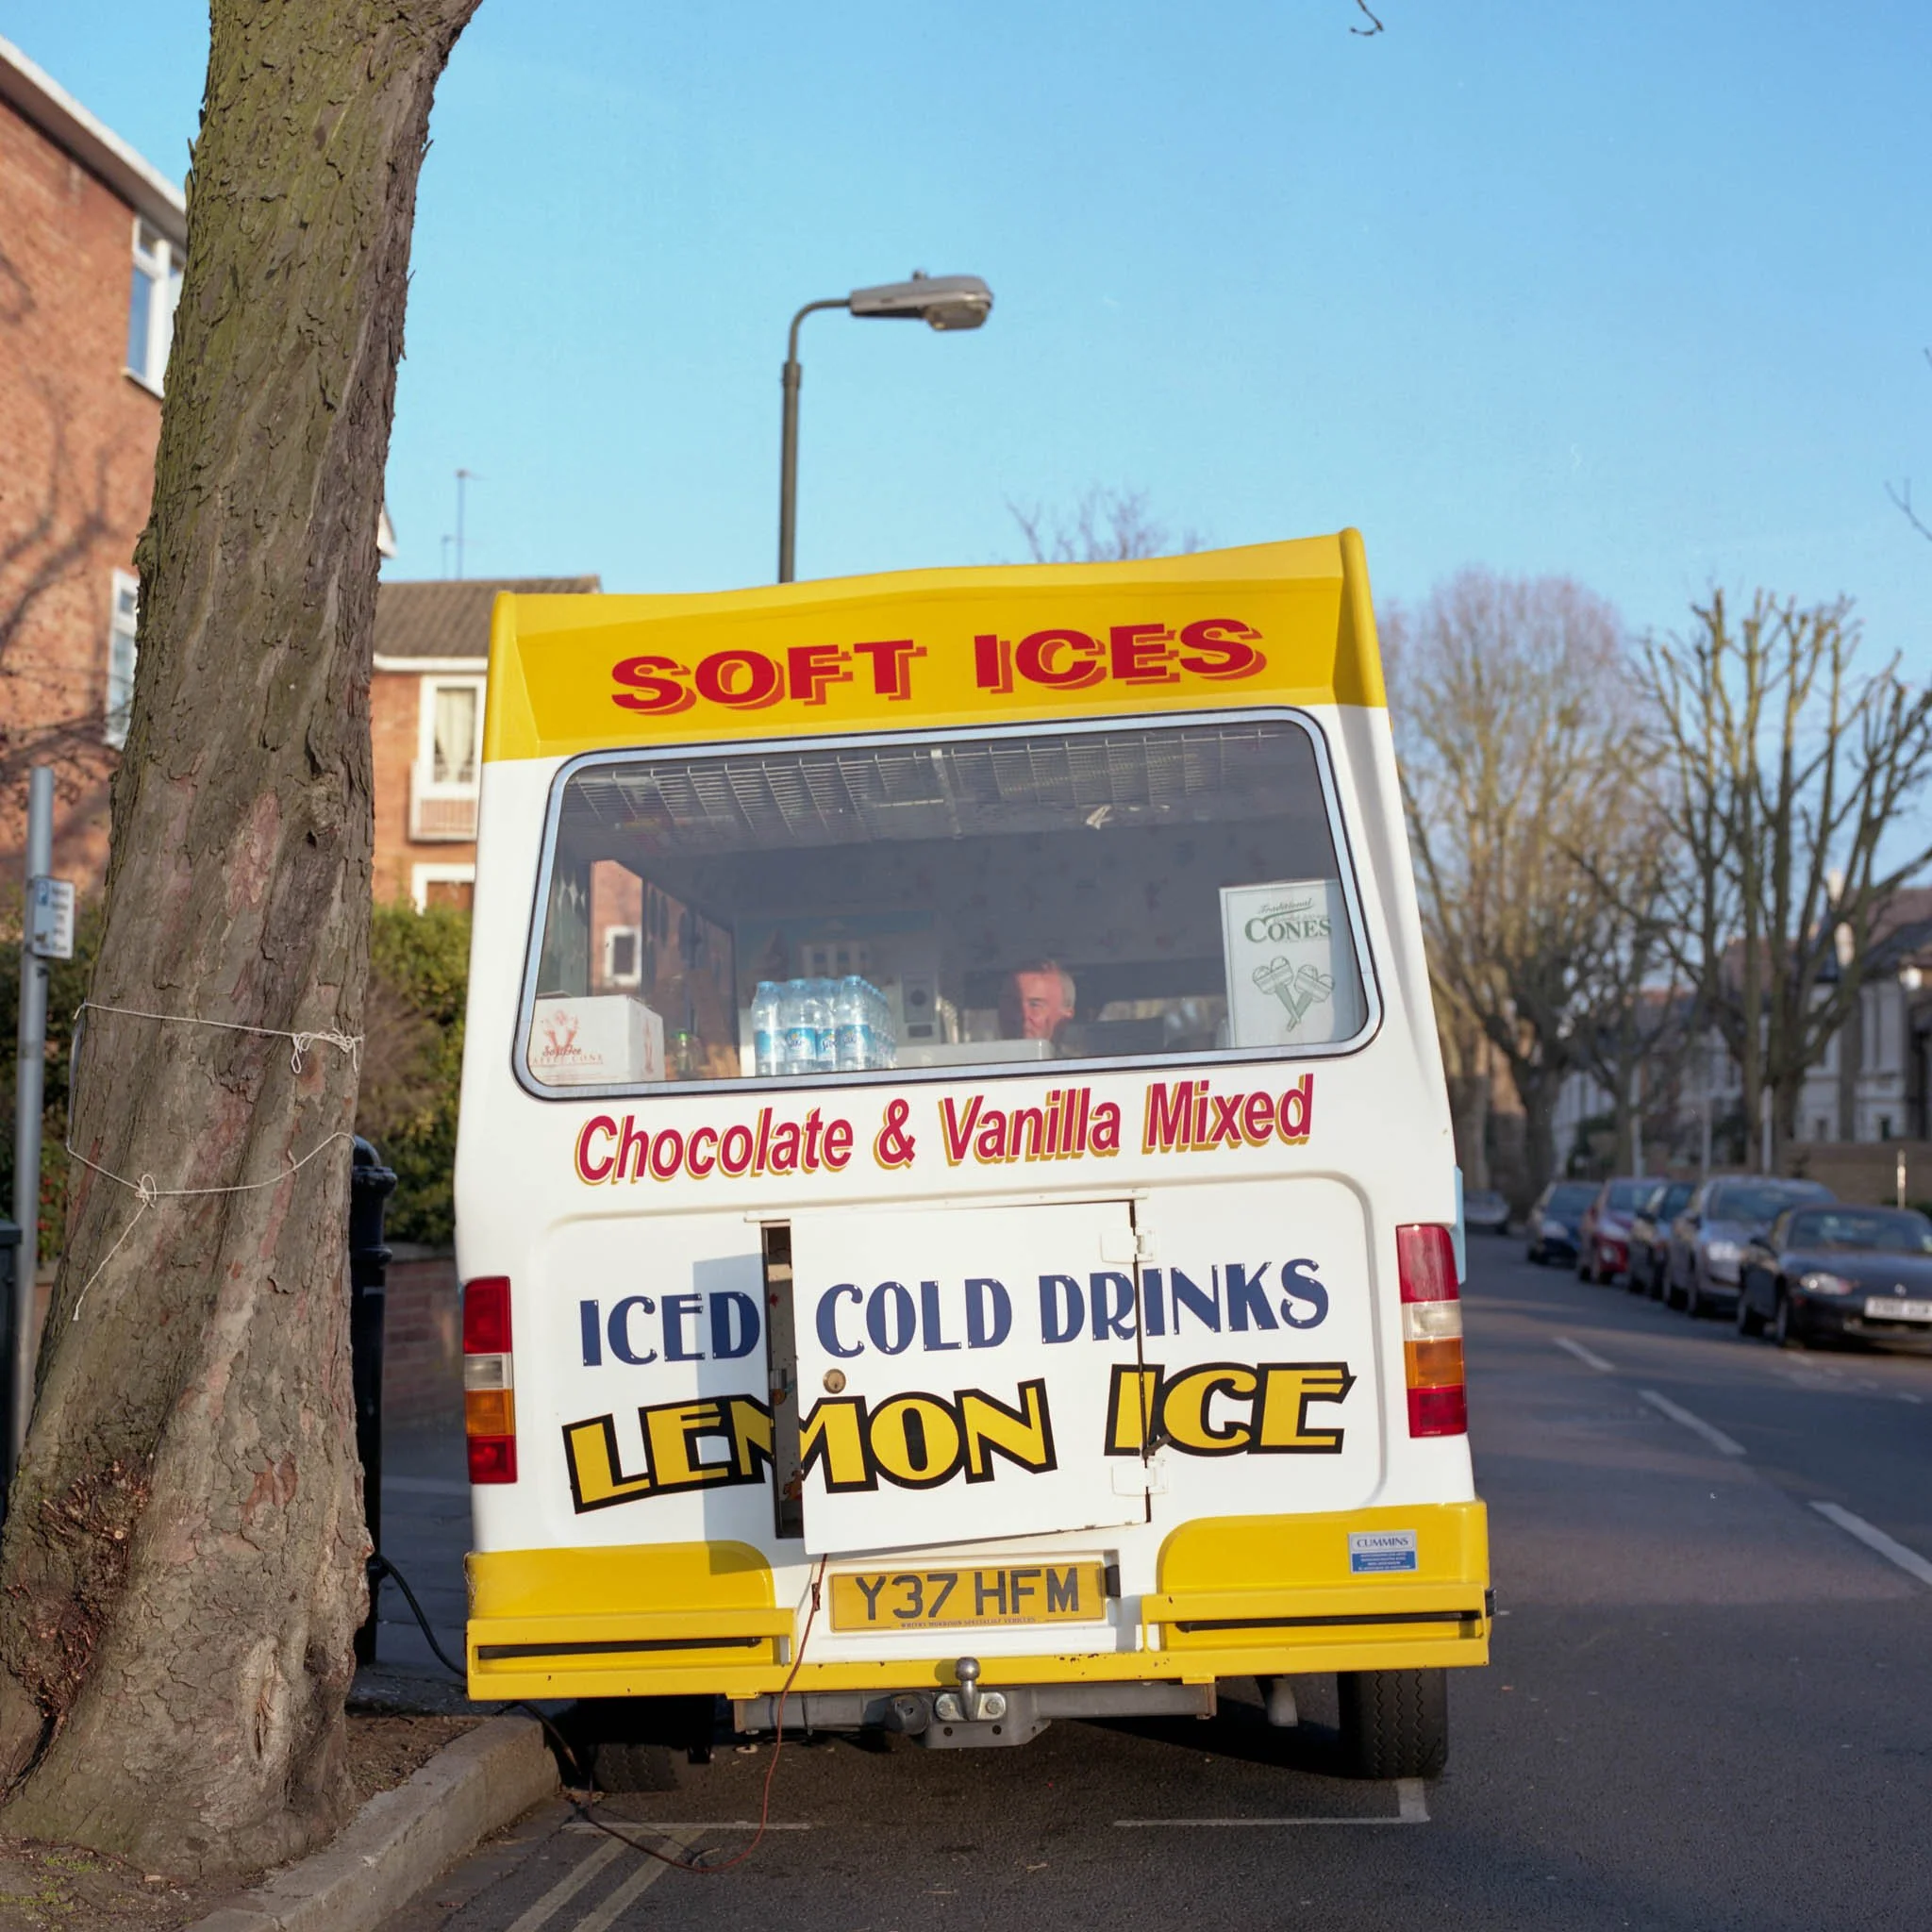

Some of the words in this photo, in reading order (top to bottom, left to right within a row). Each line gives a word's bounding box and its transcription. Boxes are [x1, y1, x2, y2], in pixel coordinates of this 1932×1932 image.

[611, 639, 927, 717] SOFT
[974, 618, 1268, 694] ICES
[1244, 917, 1331, 943] CONES
[1257, 897, 1313, 914] Traditional
[575, 1108, 854, 1187] Chocolate
[874, 1099, 916, 1171] &
[938, 1087, 1121, 1168] Vanilla
[1141, 1073, 1314, 1156] Mixed
[580, 1291, 762, 1367] ICED
[817, 1278, 1012, 1357] COLD
[1040, 1257, 1330, 1344] DRINKS
[561, 1377, 1058, 1515] LEMON
[1105, 1362, 1357, 1457] ICE
[1357, 1537, 1408, 1547] CUMMINS
[856, 1574, 958, 1621] Y37
[974, 1567, 1079, 1616] HFM
